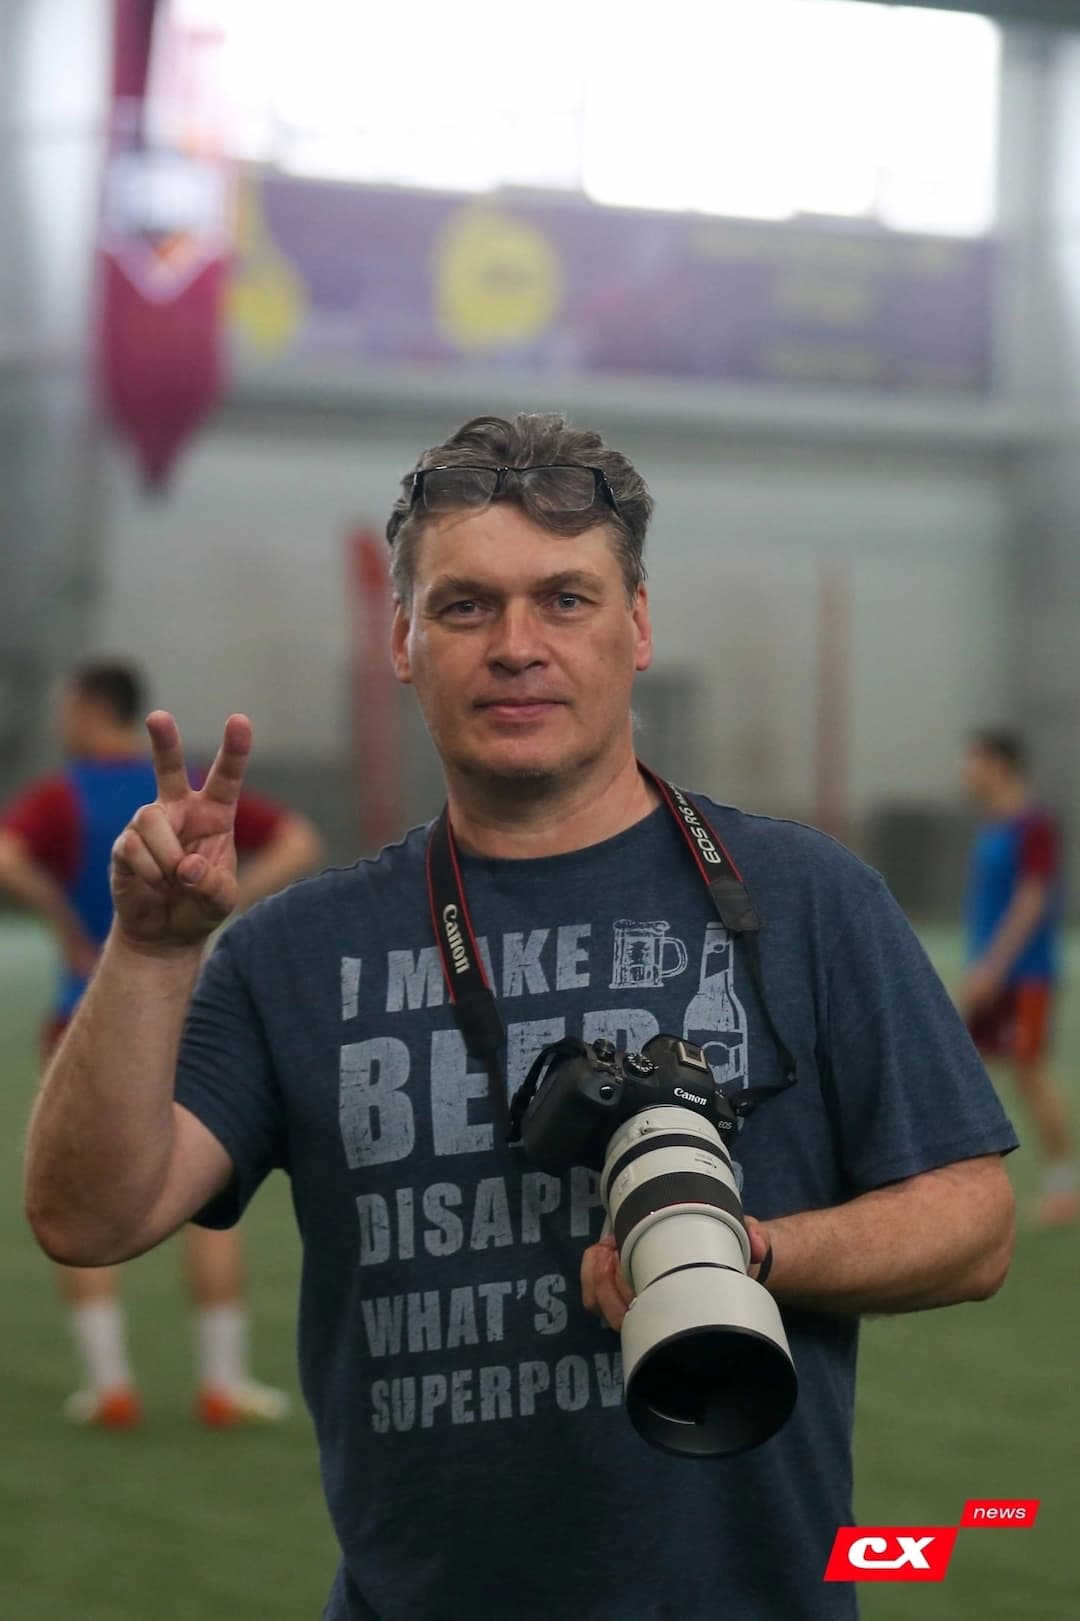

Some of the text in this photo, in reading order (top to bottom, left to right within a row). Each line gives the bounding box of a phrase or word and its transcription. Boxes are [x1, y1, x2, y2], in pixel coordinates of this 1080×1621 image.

[678, 805, 700, 826] R6
[690, 826, 721, 863] EOS
[442, 904, 470, 974] Canon
[341, 956, 361, 1021] I
[673, 1087, 707, 1106] Canon
[718, 1120, 733, 1130] EOS
[355, 1165, 606, 1267] DISAPP
[361, 1274, 568, 1357] WHAT'S
